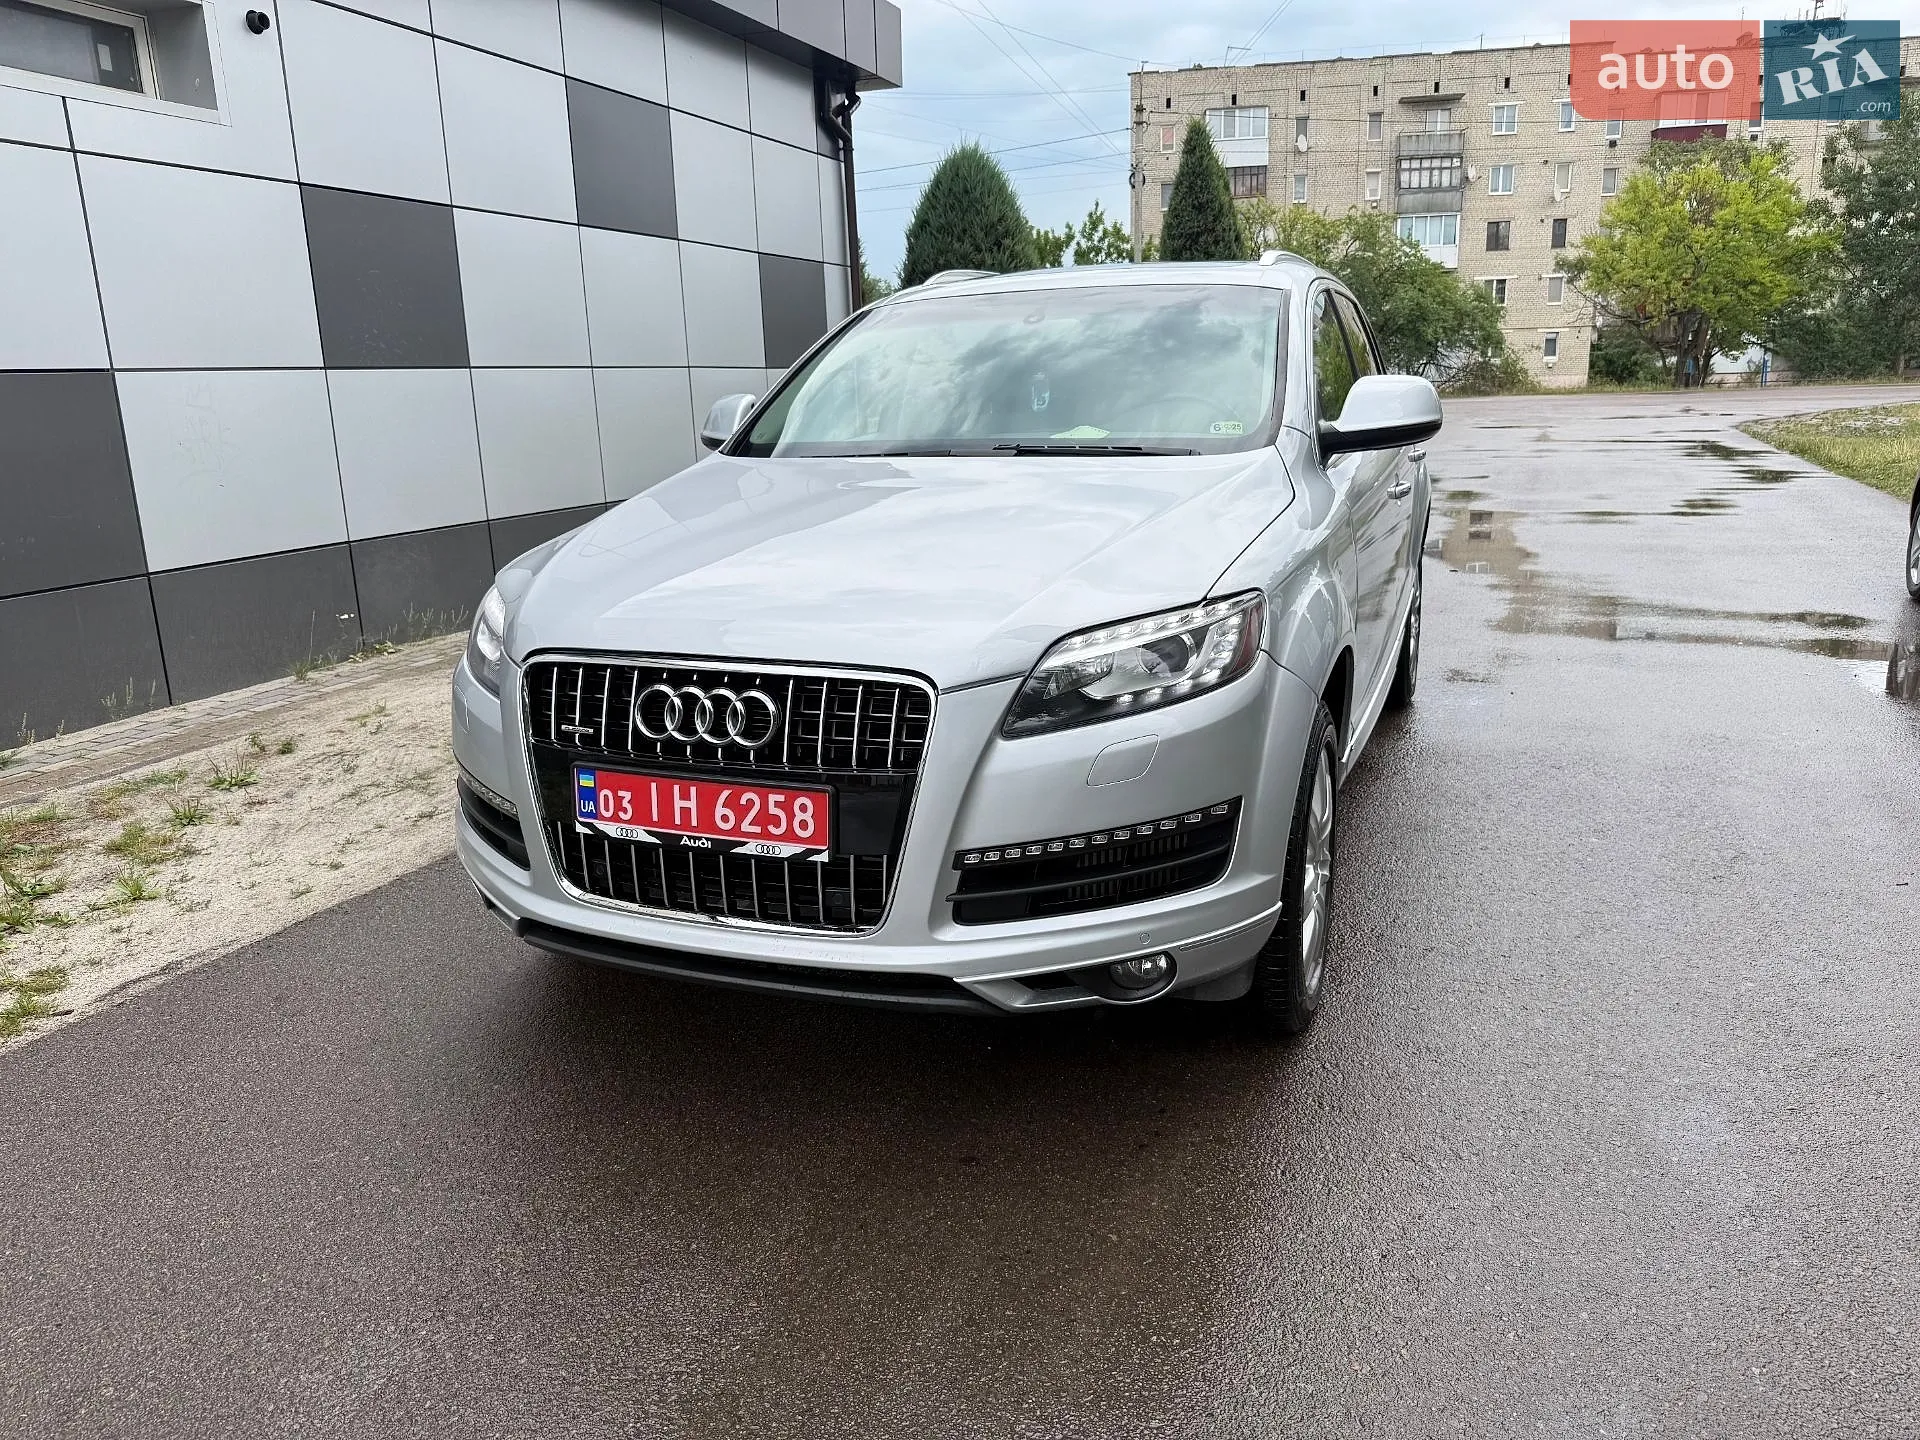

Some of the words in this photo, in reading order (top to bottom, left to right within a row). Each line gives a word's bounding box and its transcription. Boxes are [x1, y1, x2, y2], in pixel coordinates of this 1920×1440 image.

[580, 800, 596, 814] UA
[599, 789, 633, 821] 03
[714, 789, 815, 838] 6258
[680, 835, 712, 849] Audi
